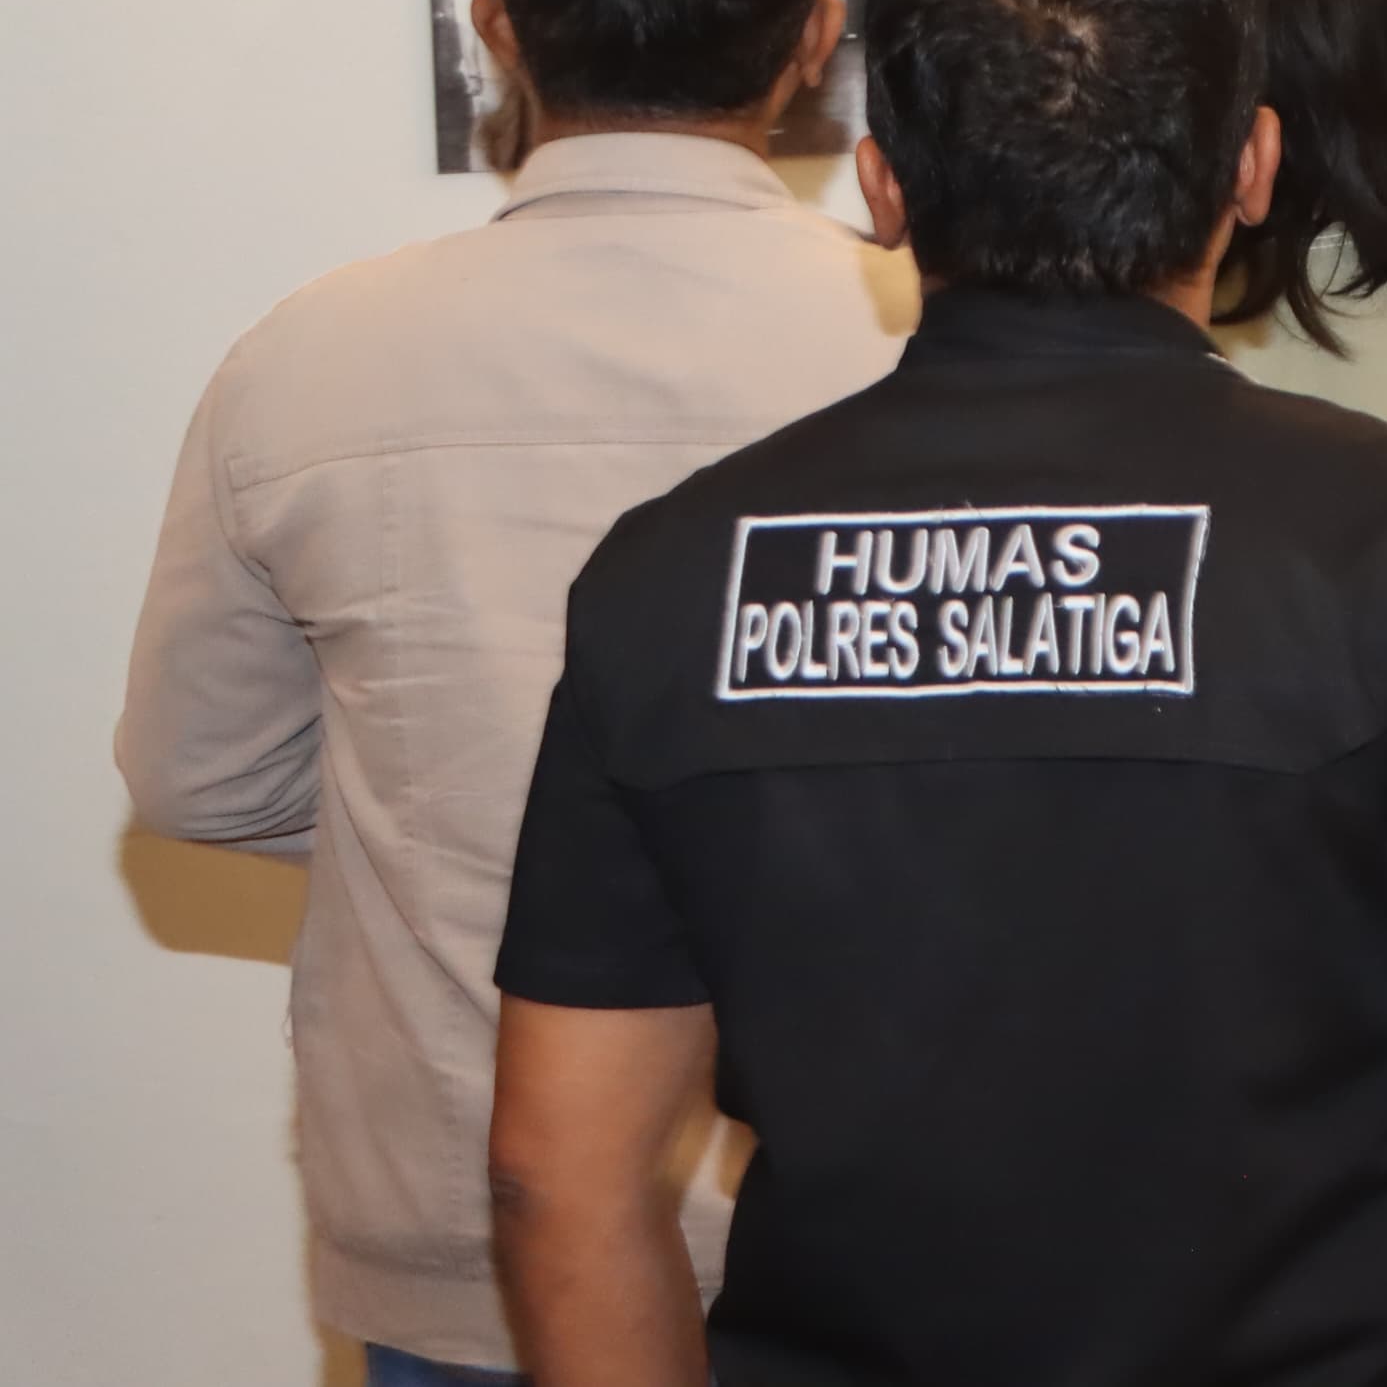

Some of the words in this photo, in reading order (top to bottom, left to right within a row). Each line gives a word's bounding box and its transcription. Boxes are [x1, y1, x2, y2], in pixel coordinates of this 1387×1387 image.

[816, 523, 1102, 595] HUMAS
[735, 599, 920, 682] POLRES
[938, 591, 1176, 678] SALATIGA
